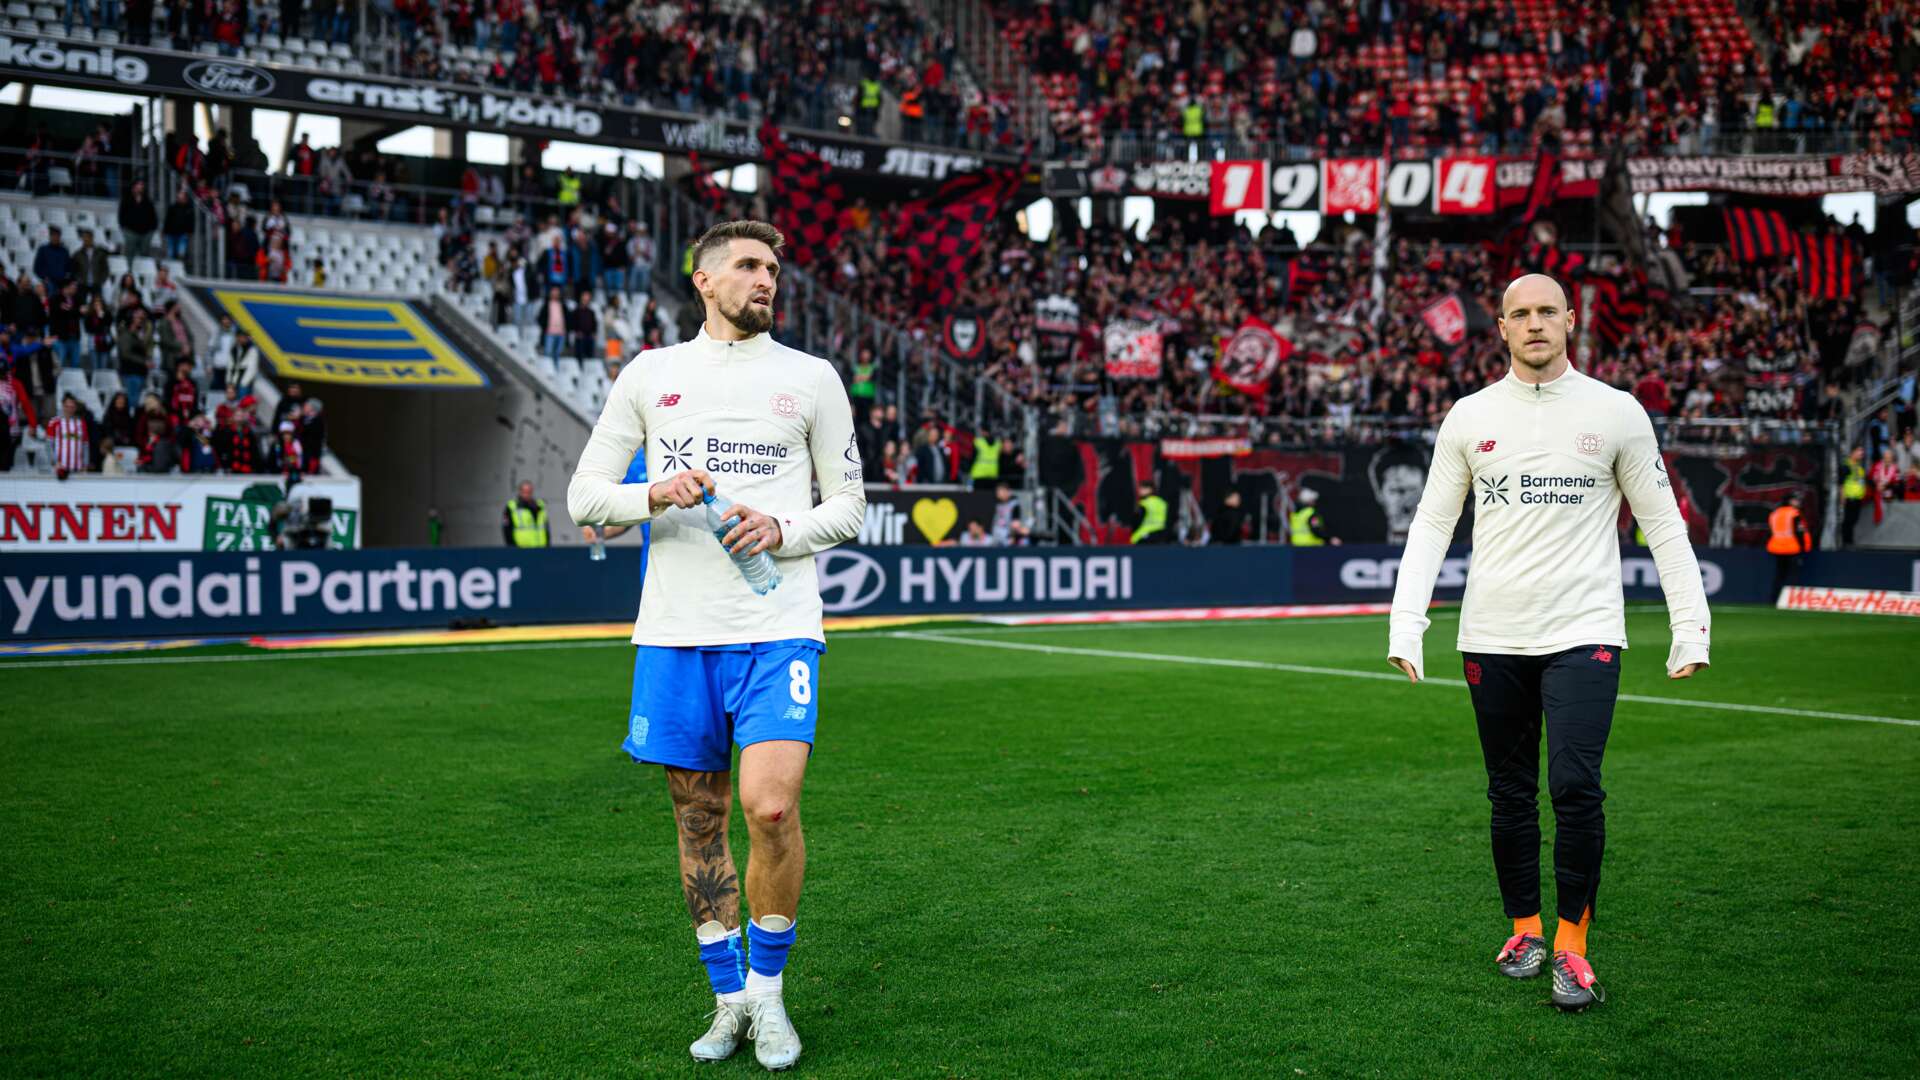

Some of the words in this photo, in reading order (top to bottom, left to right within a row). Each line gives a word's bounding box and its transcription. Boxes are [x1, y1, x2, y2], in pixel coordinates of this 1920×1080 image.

[0, 36, 149, 85] könig
[201, 63, 259, 94] Ford
[306, 79, 445, 114] ernst
[482, 94, 603, 137] könig
[289, 358, 456, 378] EDEKA
[705, 457, 777, 476] Gothaer
[706, 438, 788, 459] Barmenia
[1520, 474, 1596, 488] Barmenia
[1520, 491, 1585, 505] Gothaer
[0, 502, 182, 542] NNEN
[858, 502, 908, 546] Wir
[3, 556, 261, 634] yundai
[281, 560, 521, 614] Partner
[900, 556, 1132, 601] HYUNDAI
[789, 660, 811, 705] 8
